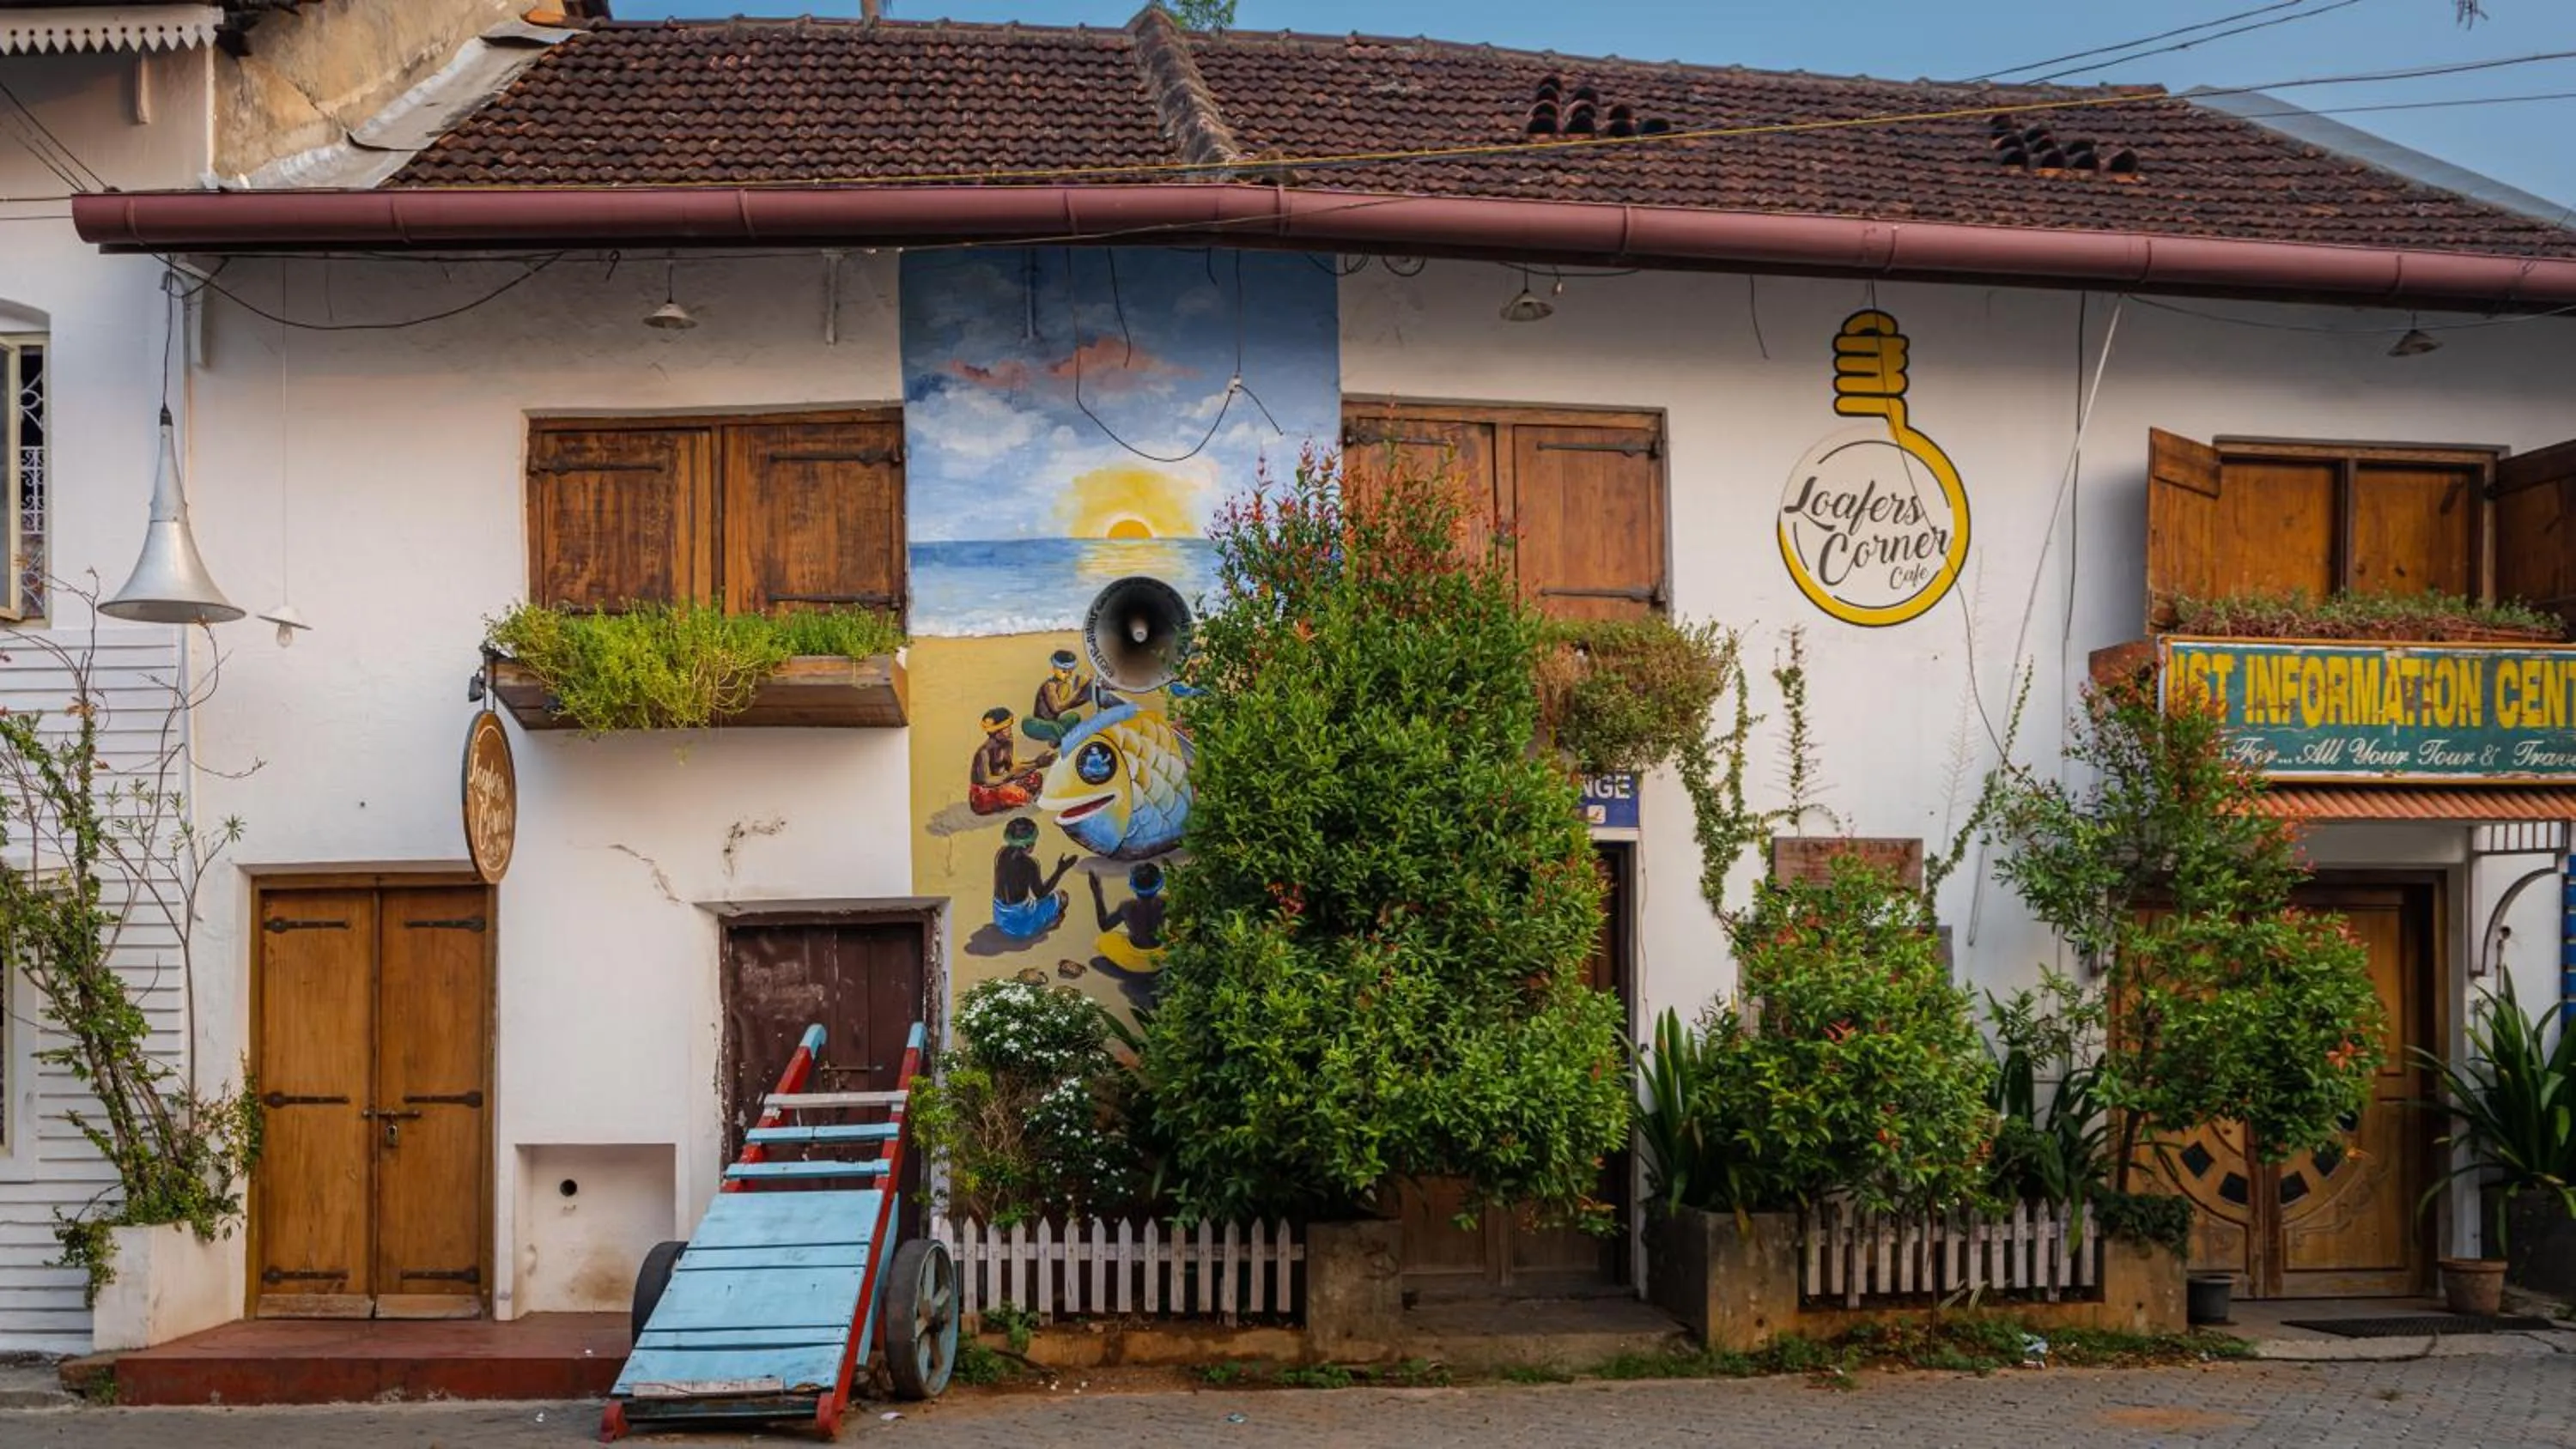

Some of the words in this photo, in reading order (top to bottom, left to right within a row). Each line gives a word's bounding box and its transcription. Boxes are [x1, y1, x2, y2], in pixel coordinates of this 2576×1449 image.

[1783, 476, 1923, 536] Loafers
[1819, 525, 1950, 585] Corner
[1889, 564, 1929, 590] Cafe
[2245, 653, 2482, 729] INFORMATION
[2296, 737, 2342, 765] All
[2348, 737, 2410, 767] Your
[2417, 739, 2476, 767] Tour
[2480, 744, 2500, 766] &
